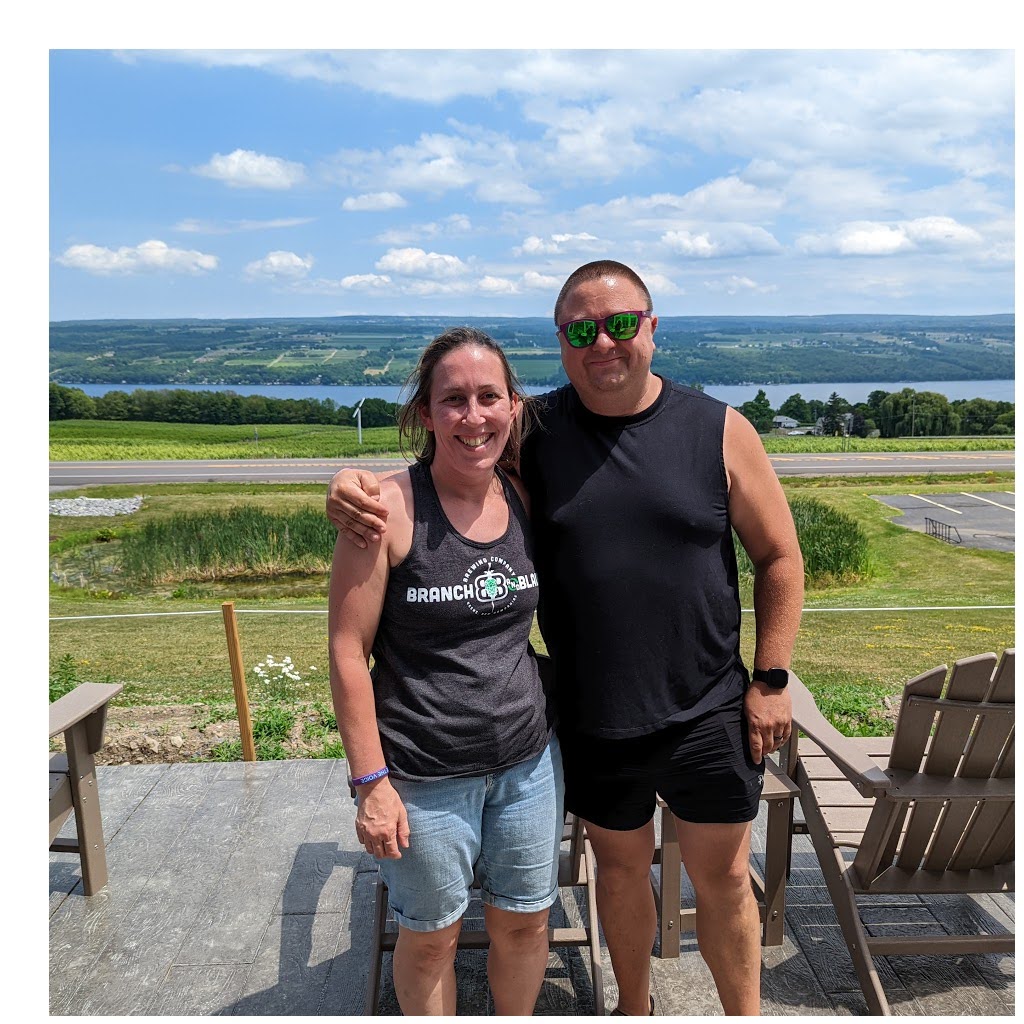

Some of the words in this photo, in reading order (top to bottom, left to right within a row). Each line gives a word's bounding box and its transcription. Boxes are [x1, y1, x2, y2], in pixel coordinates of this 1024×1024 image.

[463, 557, 487, 583] BREWING
[490, 556, 516, 576] COMPANY
[406, 583, 475, 603] BRANCH
